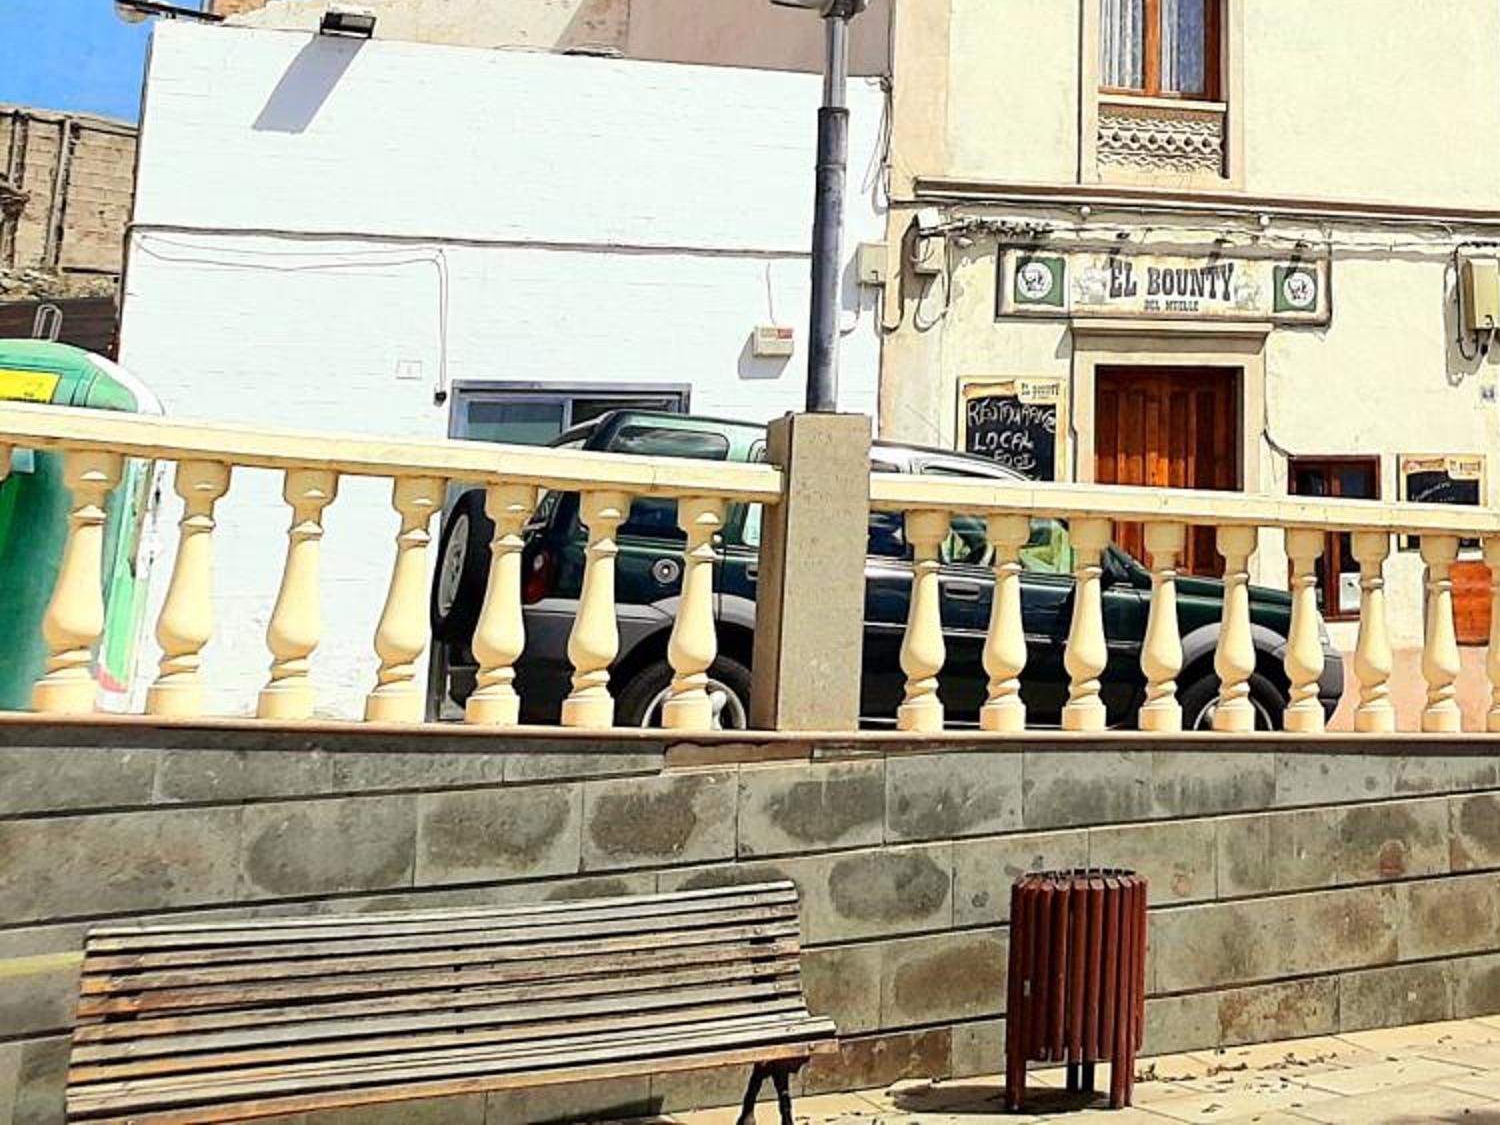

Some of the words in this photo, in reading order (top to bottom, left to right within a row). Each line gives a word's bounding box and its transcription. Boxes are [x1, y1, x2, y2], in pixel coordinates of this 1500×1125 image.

[1110, 257, 1137, 298] EL
[1147, 262, 1234, 301] BOUNTY
[974, 431, 1035, 452] LOCAL
